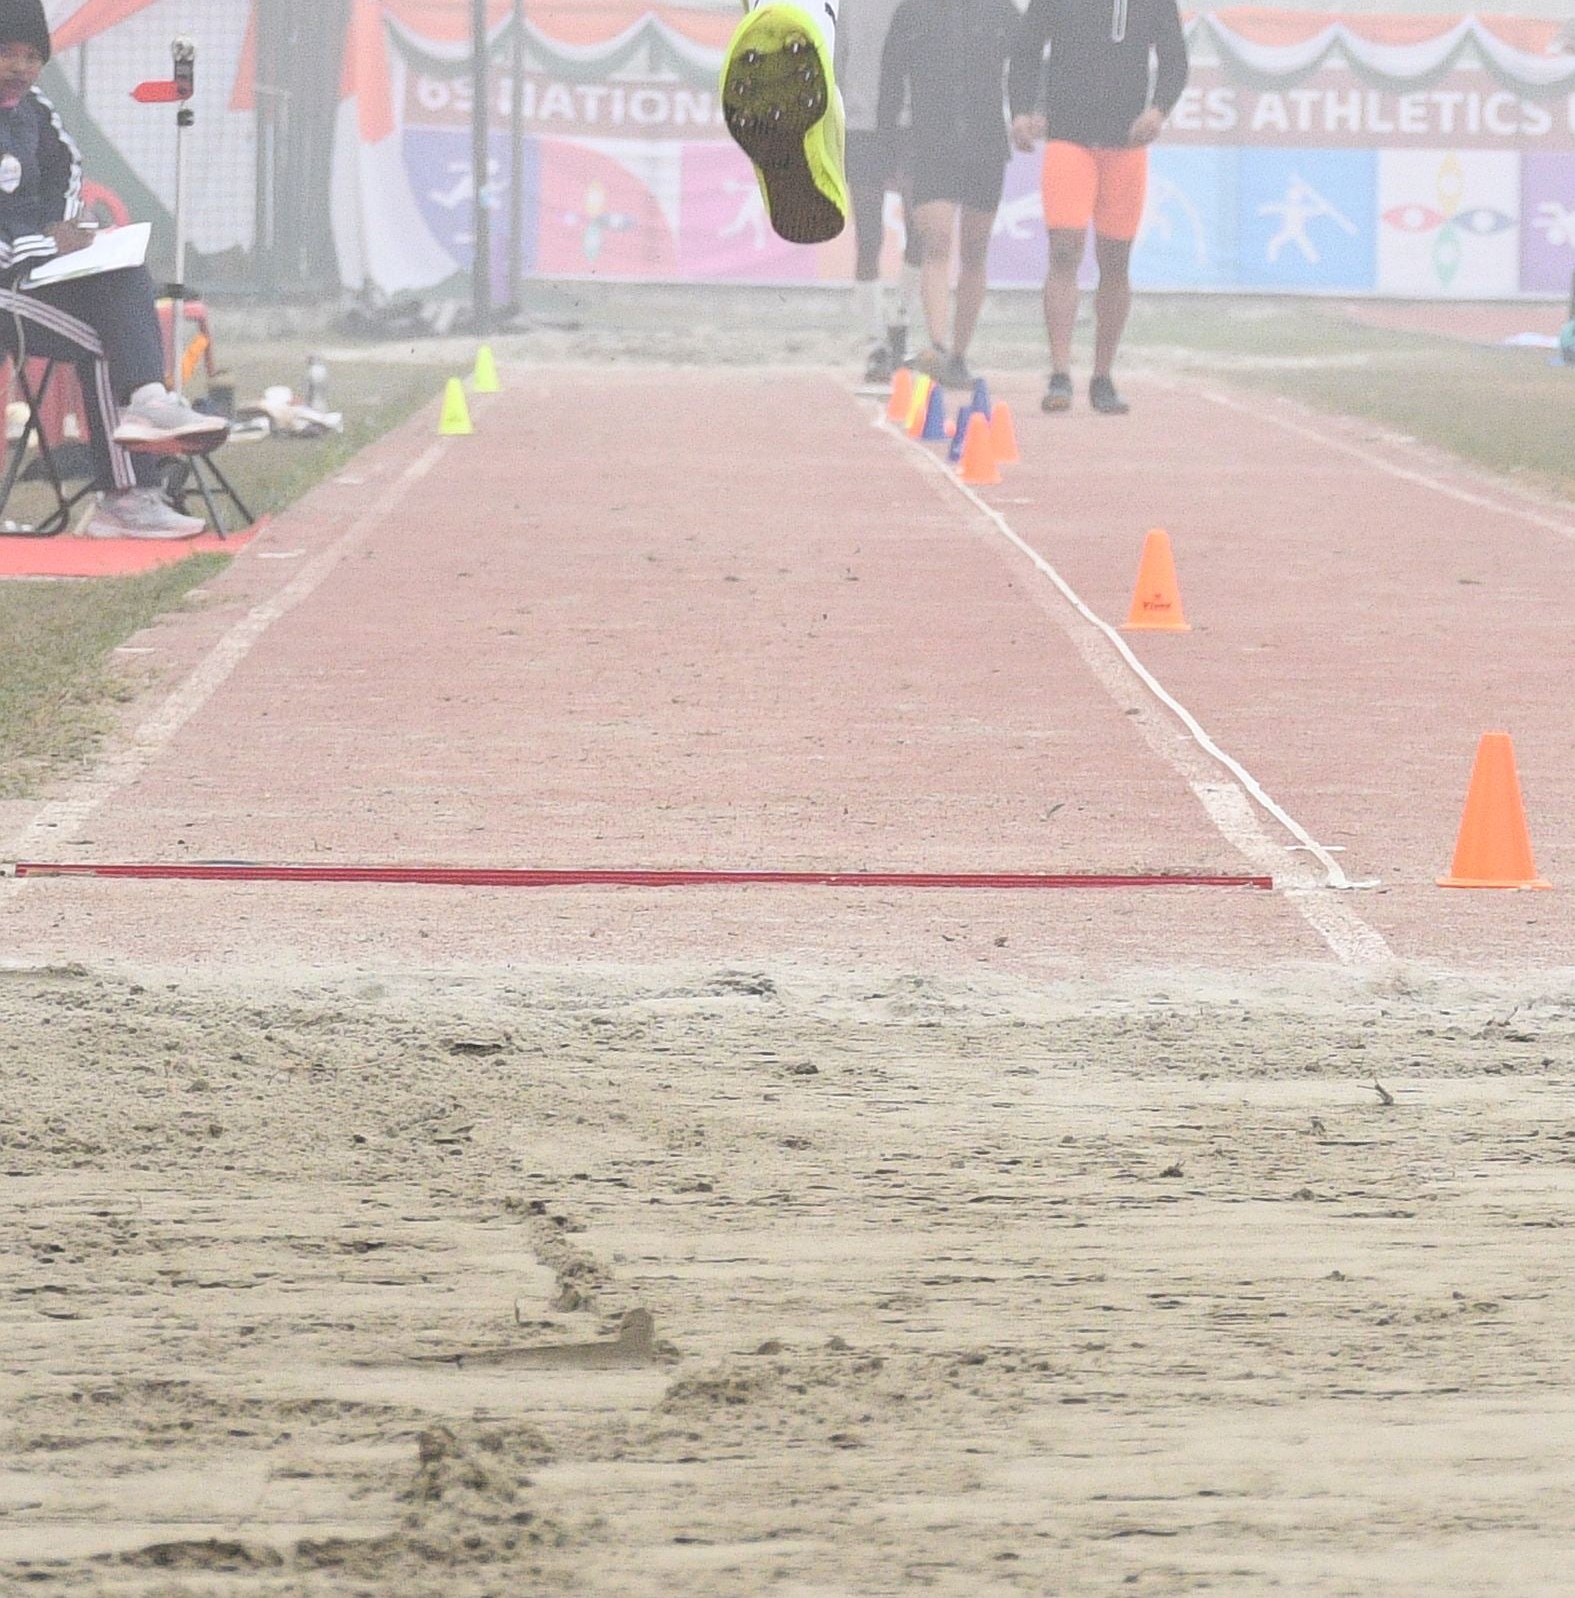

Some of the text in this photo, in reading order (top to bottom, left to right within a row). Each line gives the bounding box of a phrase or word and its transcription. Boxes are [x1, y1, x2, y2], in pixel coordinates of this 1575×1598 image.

[500, 77, 724, 125] NATION
[1161, 88, 1239, 131] ES
[1252, 88, 1553, 135] ATHLETICS
